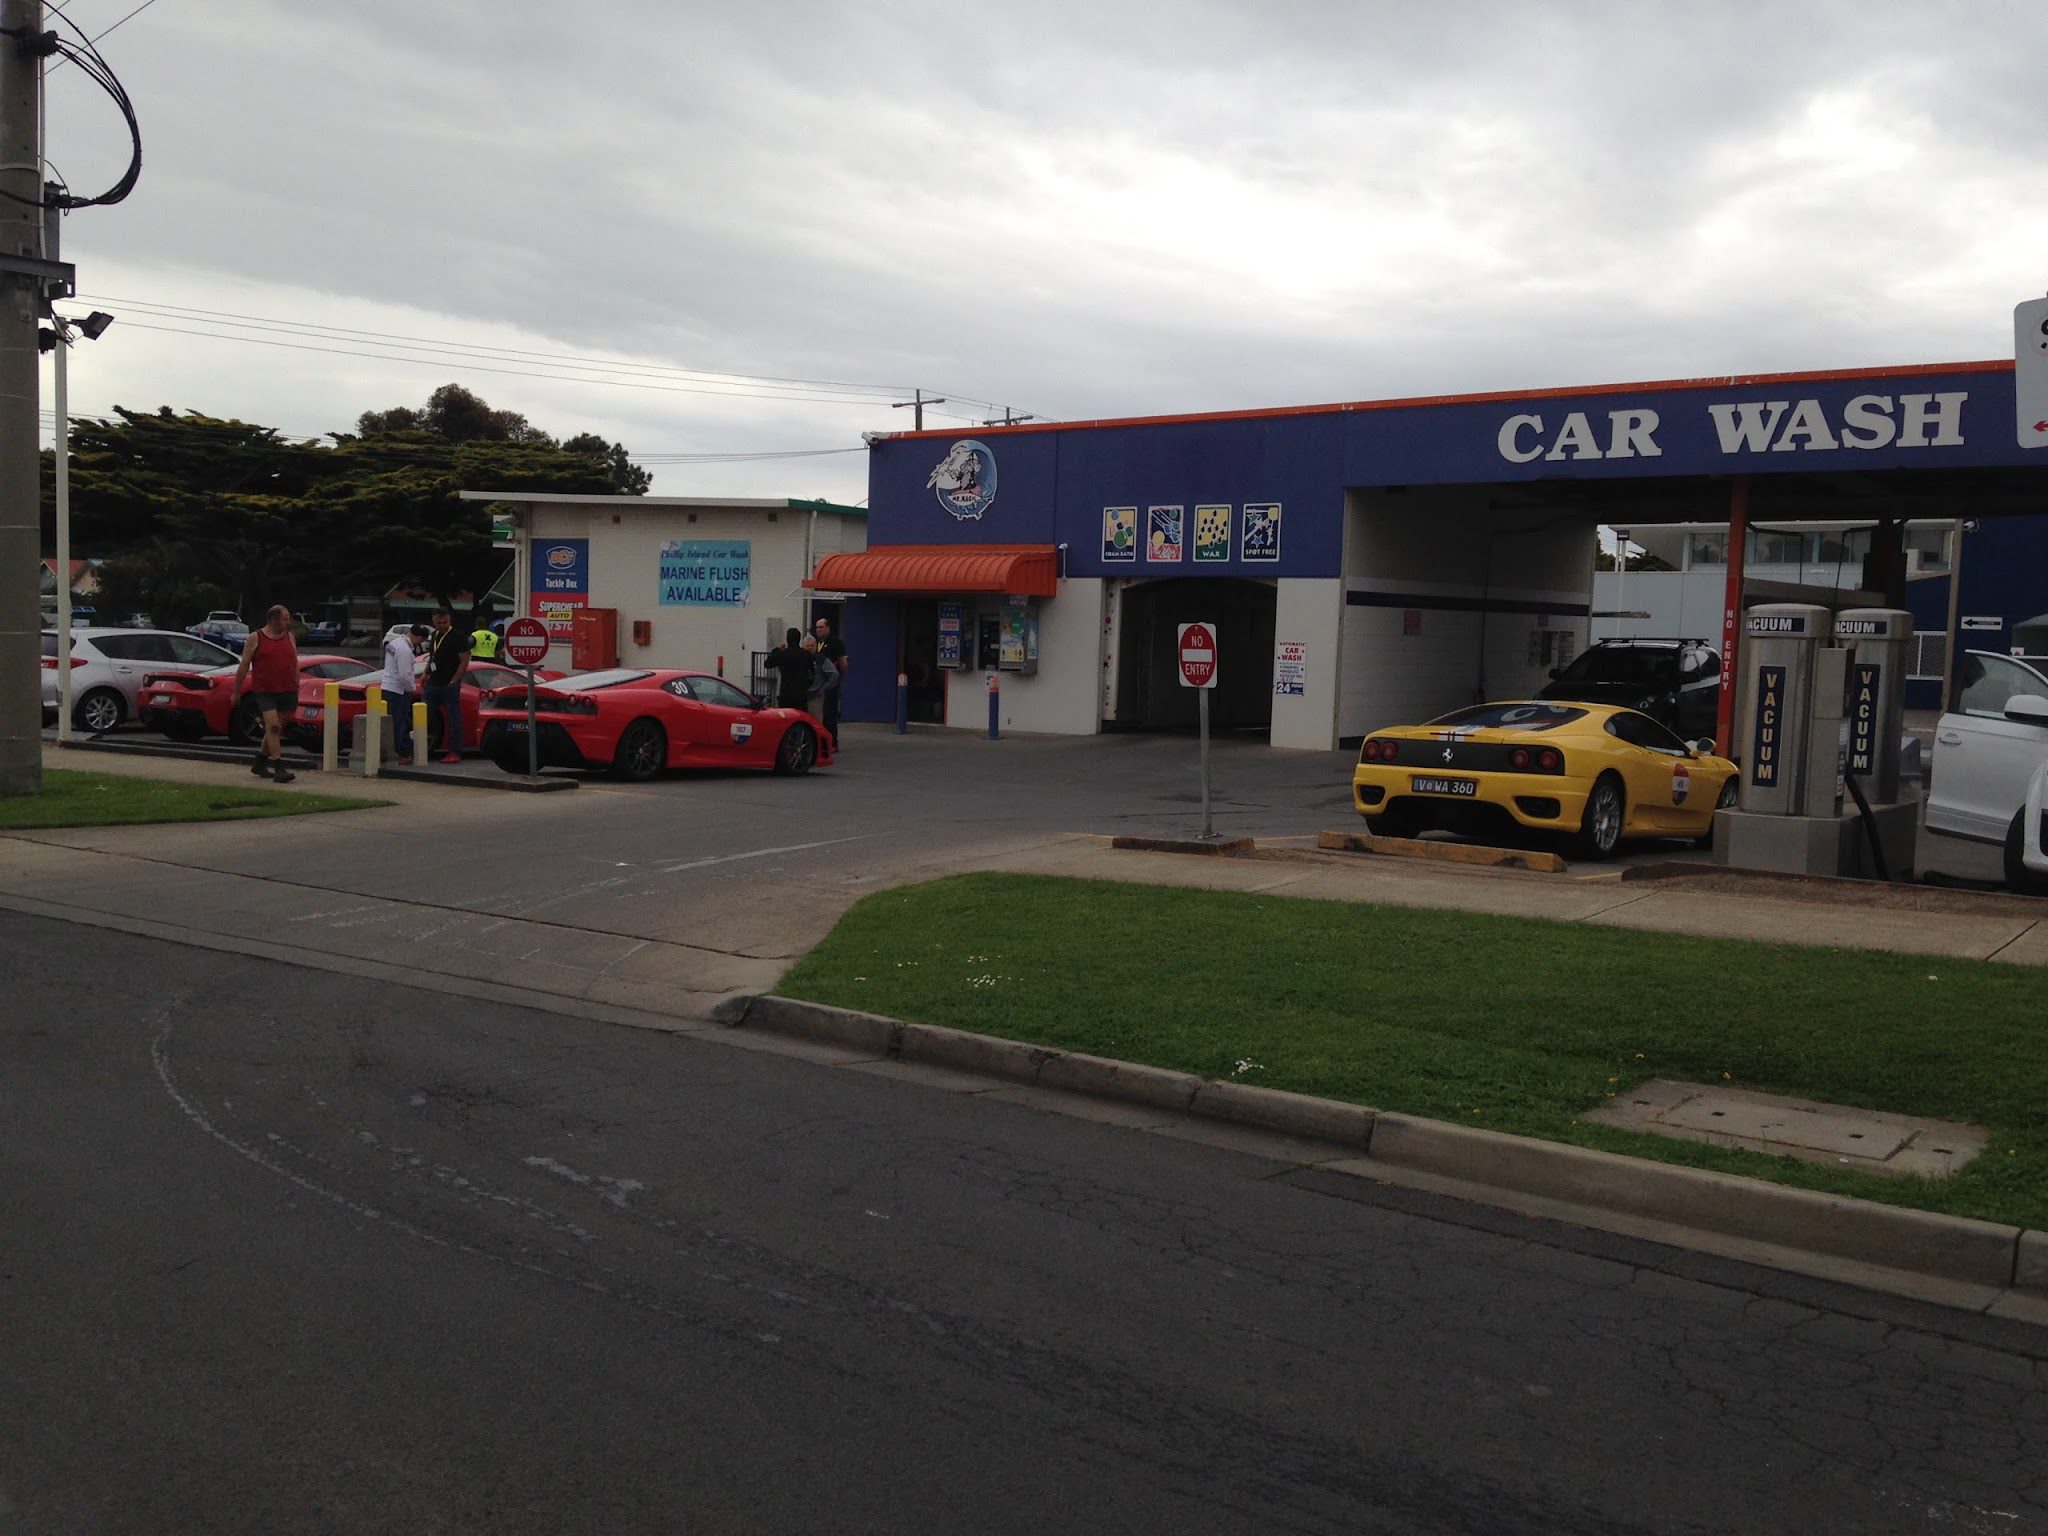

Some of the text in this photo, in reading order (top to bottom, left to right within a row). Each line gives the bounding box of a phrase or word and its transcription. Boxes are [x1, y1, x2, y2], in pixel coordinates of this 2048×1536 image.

[1498, 392, 1968, 463] CAR WASH
[1261, 548, 1276, 556] FREE
[660, 566, 748, 581] MARINE FLUSH
[545, 578, 577, 588] Tackle Box
[667, 586, 741, 602] AVAILABLE
[520, 626, 534, 636] NO
[1191, 635, 1203, 647] NO
[512, 648, 542, 657] ENTRY
[1721, 610, 1734, 690] NO ENTRY
[1185, 663, 1211, 676] ENTRY
[671, 681, 689, 695] 30
[1277, 683, 1291, 693] 24
[1853, 671, 1873, 769] VACUUM
[1757, 674, 1778, 780] VACUUM
[1452, 782, 1474, 794] 360
